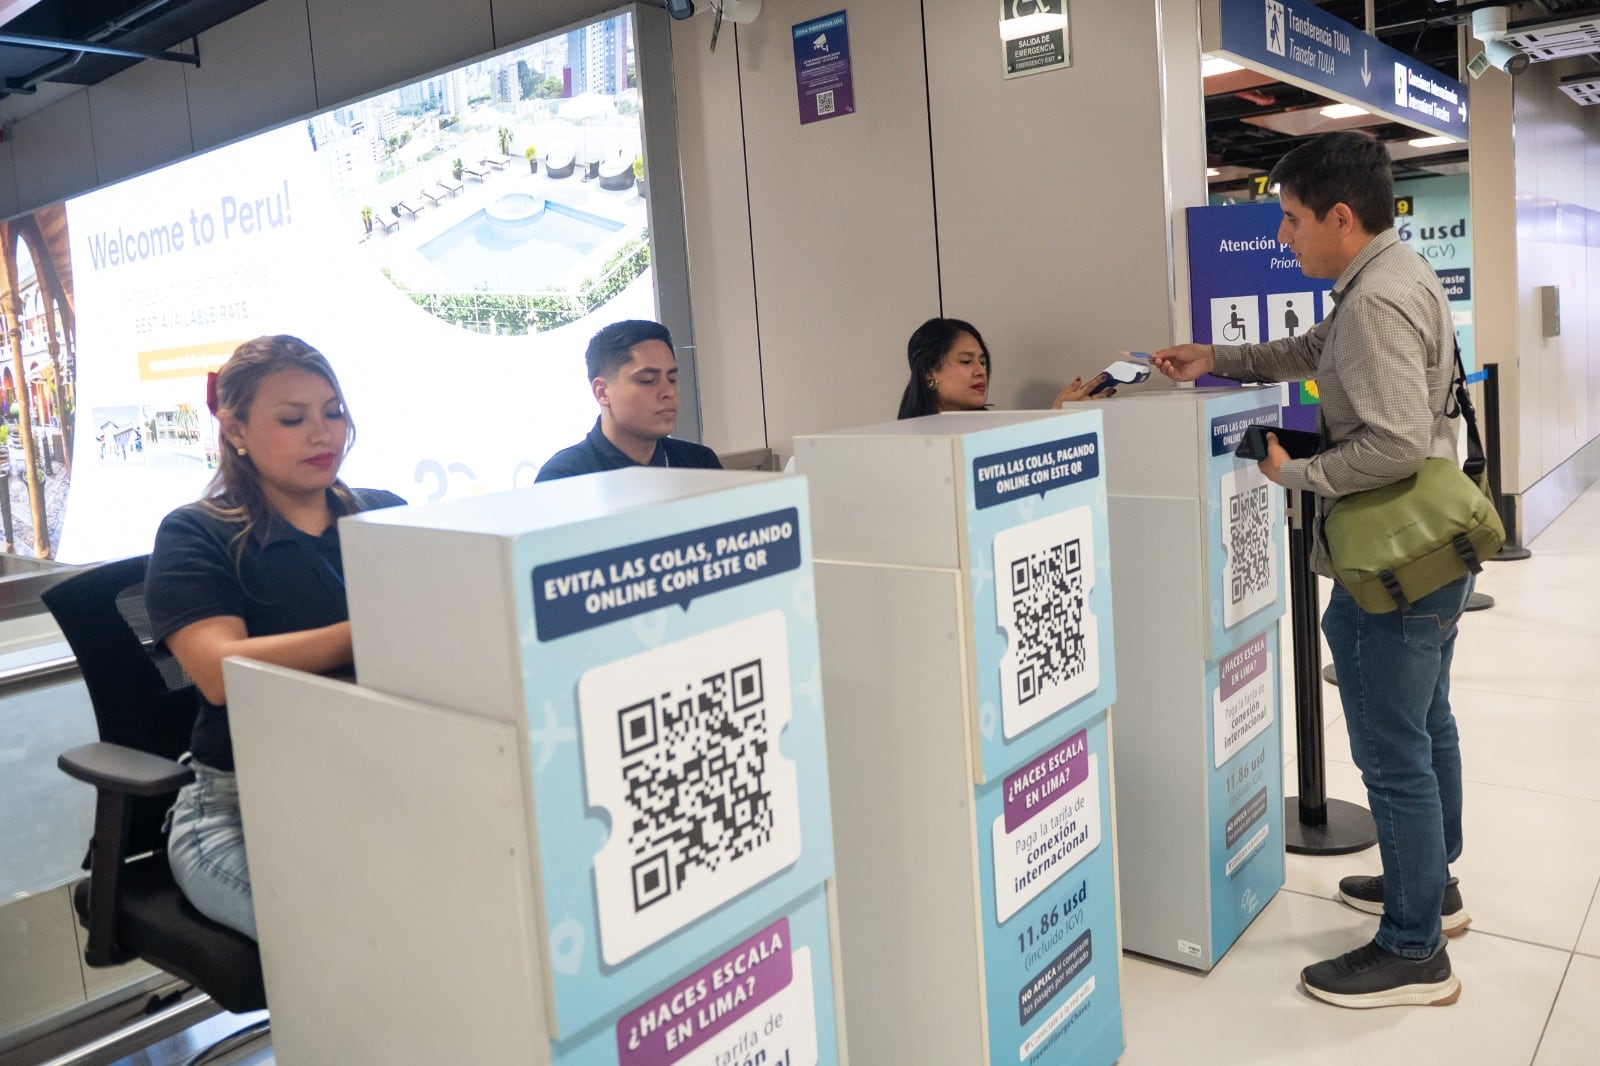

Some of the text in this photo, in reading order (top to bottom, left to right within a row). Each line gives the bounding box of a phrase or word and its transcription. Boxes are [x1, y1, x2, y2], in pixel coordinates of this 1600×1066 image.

[1015, 43, 1054, 58] EMERGENCIA
[1019, 34, 1050, 48] SALIDA DE
[1288, 8, 1351, 56] Transferencia TUUA
[1016, 58, 1044, 70] EMERGENCY
[1290, 38, 1335, 76] Transfer TUUA
[1254, 176, 1269, 194] 7
[88, 179, 292, 271] Welcome to Peru!
[1397, 200, 1409, 214] 9
[1220, 236, 1276, 252] Atención
[1420, 218, 1466, 240] usd
[1440, 275, 1466, 284] raste
[162, 306, 216, 328] AVAILABLE
[220, 301, 249, 320] RATE
[1214, 424, 1228, 436] EVITA
[1229, 421, 1239, 432] LAS
[1256, 412, 1278, 425] PAGANDO
[978, 442, 1095, 482] EVITA LAS COLAS, PAGANDO
[996, 461, 1082, 494] ONLINE CON ESTE QR
[544, 522, 793, 601] EVITA LAS COLAS, PAGANDO
[585, 549, 768, 615] ONLINE CON ESTE QR
[1222, 640, 1265, 679] ¿HACES ESCALA
[1231, 660, 1257, 686] EN LIMA?
[1225, 702, 1238, 720] Paga
[1239, 698, 1244, 709] la
[1244, 687, 1258, 706] tarifa
[1231, 700, 1260, 729] conexión
[1224, 704, 1266, 750] internacional
[1008, 738, 1084, 803] ¿HACES ESCALA
[1025, 768, 1071, 809] EN LIMA?
[1226, 746, 1265, 794] 11.86 usd
[1016, 796, 1085, 856] Paga la tarifa de
[1027, 818, 1076, 865] conexión
[1015, 825, 1089, 893] internacional
[1018, 880, 1087, 954] 11.86 usd
[1024, 908, 1084, 972] (incluido IGV)
[628, 932, 783, 1051] ¿HACES ESCALA
[1022, 990, 1032, 1006] NO
[1034, 966, 1057, 994] APLICA
[1023, 1001, 1033, 1017] tus
[1034, 981, 1055, 1009] pasajes
[1055, 972, 1065, 991] por
[665, 976, 756, 1052] EN LIMA?
[764, 1013, 784, 1036] de
